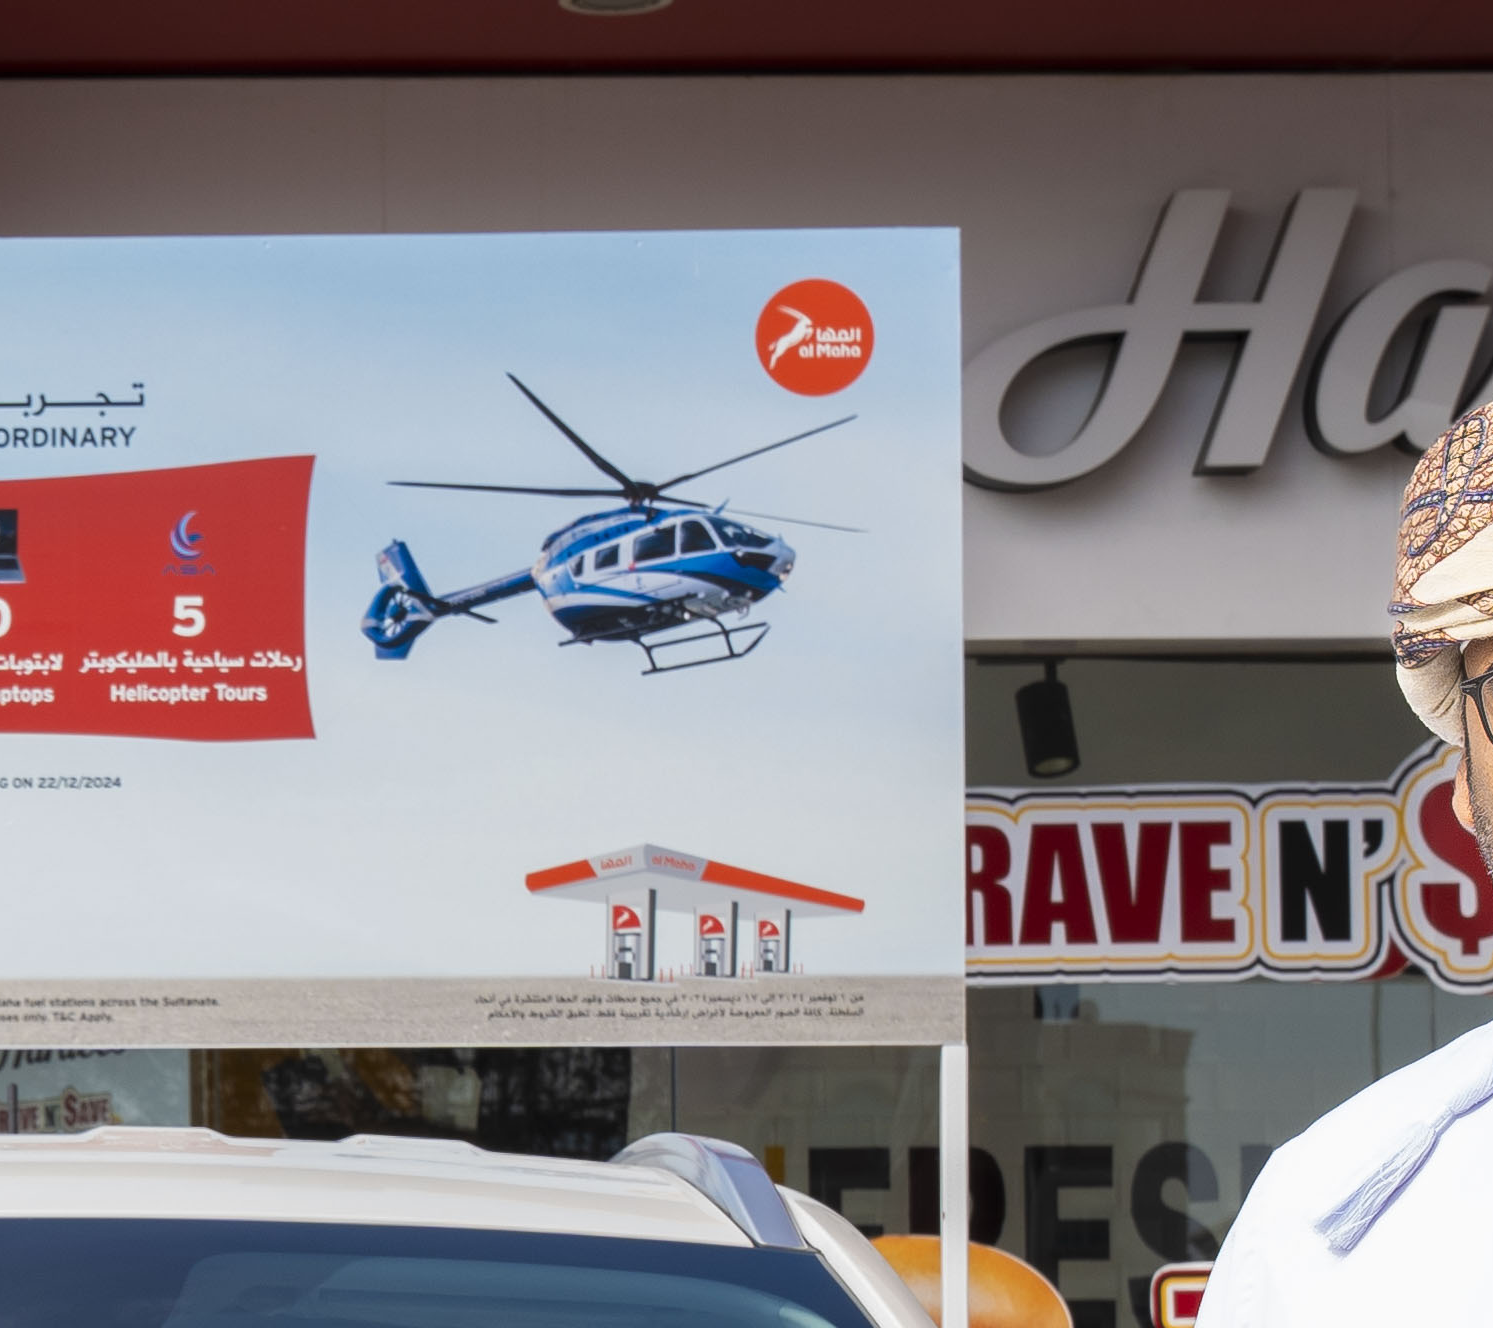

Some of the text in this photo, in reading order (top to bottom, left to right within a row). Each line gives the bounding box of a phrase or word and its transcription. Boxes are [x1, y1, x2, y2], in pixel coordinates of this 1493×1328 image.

[816, 326, 862, 342] المها
[798, 343, 862, 358] al Maha
[172, 595, 206, 637] 5
[79, 650, 303, 674] رحلات سياحية بالهليكوبتر
[110, 683, 268, 705] Helicopter Tours
[12, 777, 34, 789] ON
[965, 822, 1236, 946] RAVE
[1278, 818, 1383, 943] N'
